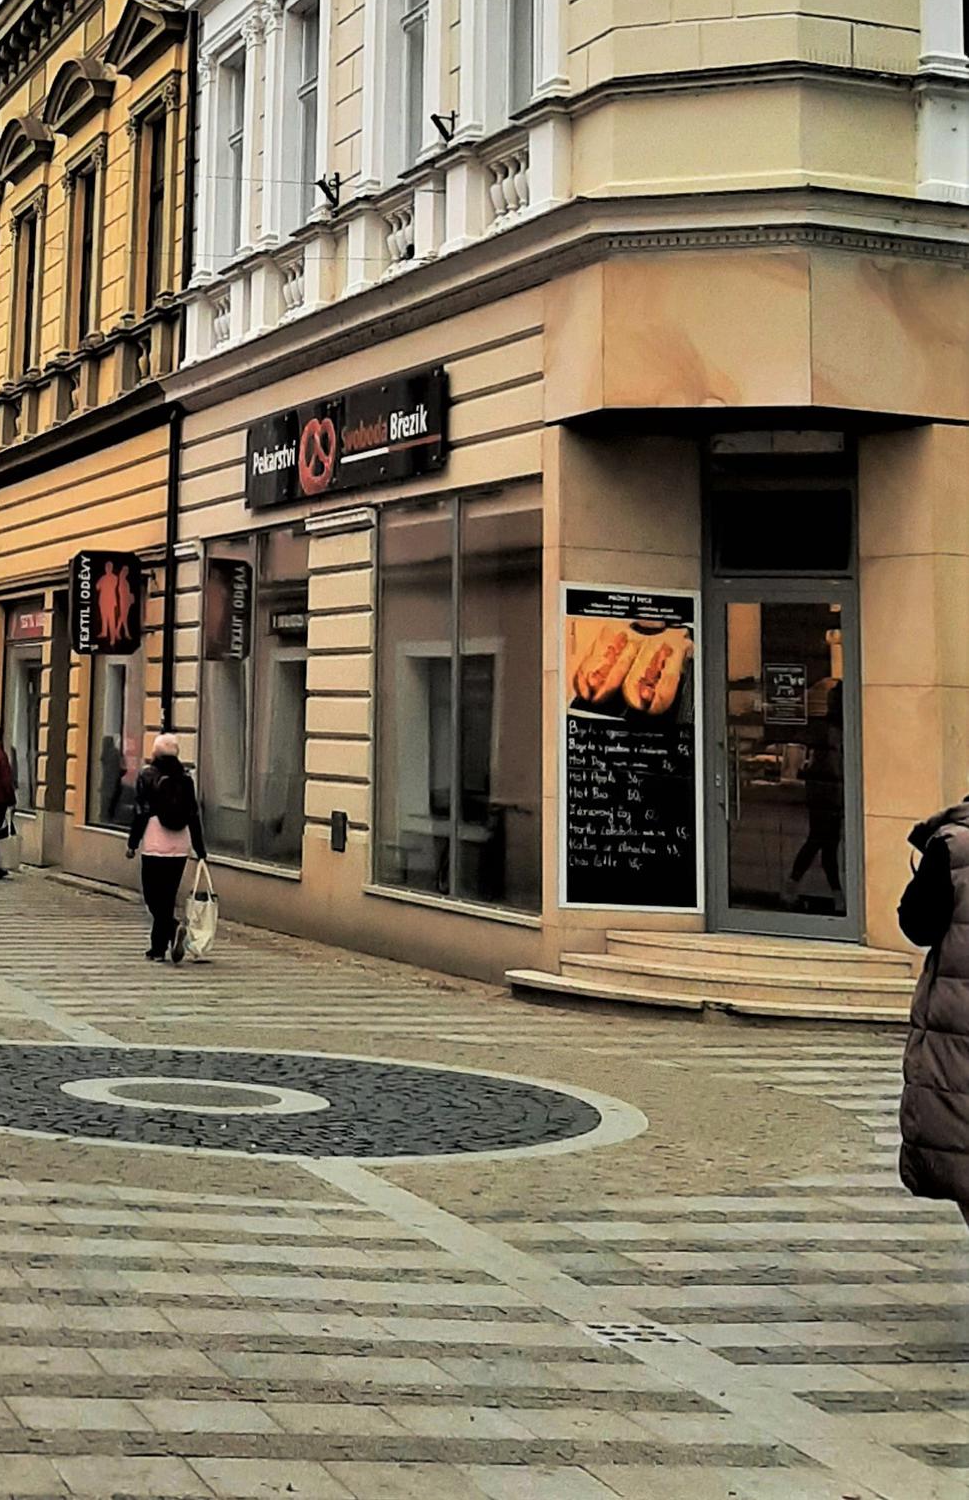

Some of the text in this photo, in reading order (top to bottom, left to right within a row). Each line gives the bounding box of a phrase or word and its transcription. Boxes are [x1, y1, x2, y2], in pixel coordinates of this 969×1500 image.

[252, 439, 296, 477] Pekařství
[78, 555, 92, 651] TEXTIL ODĚVY
